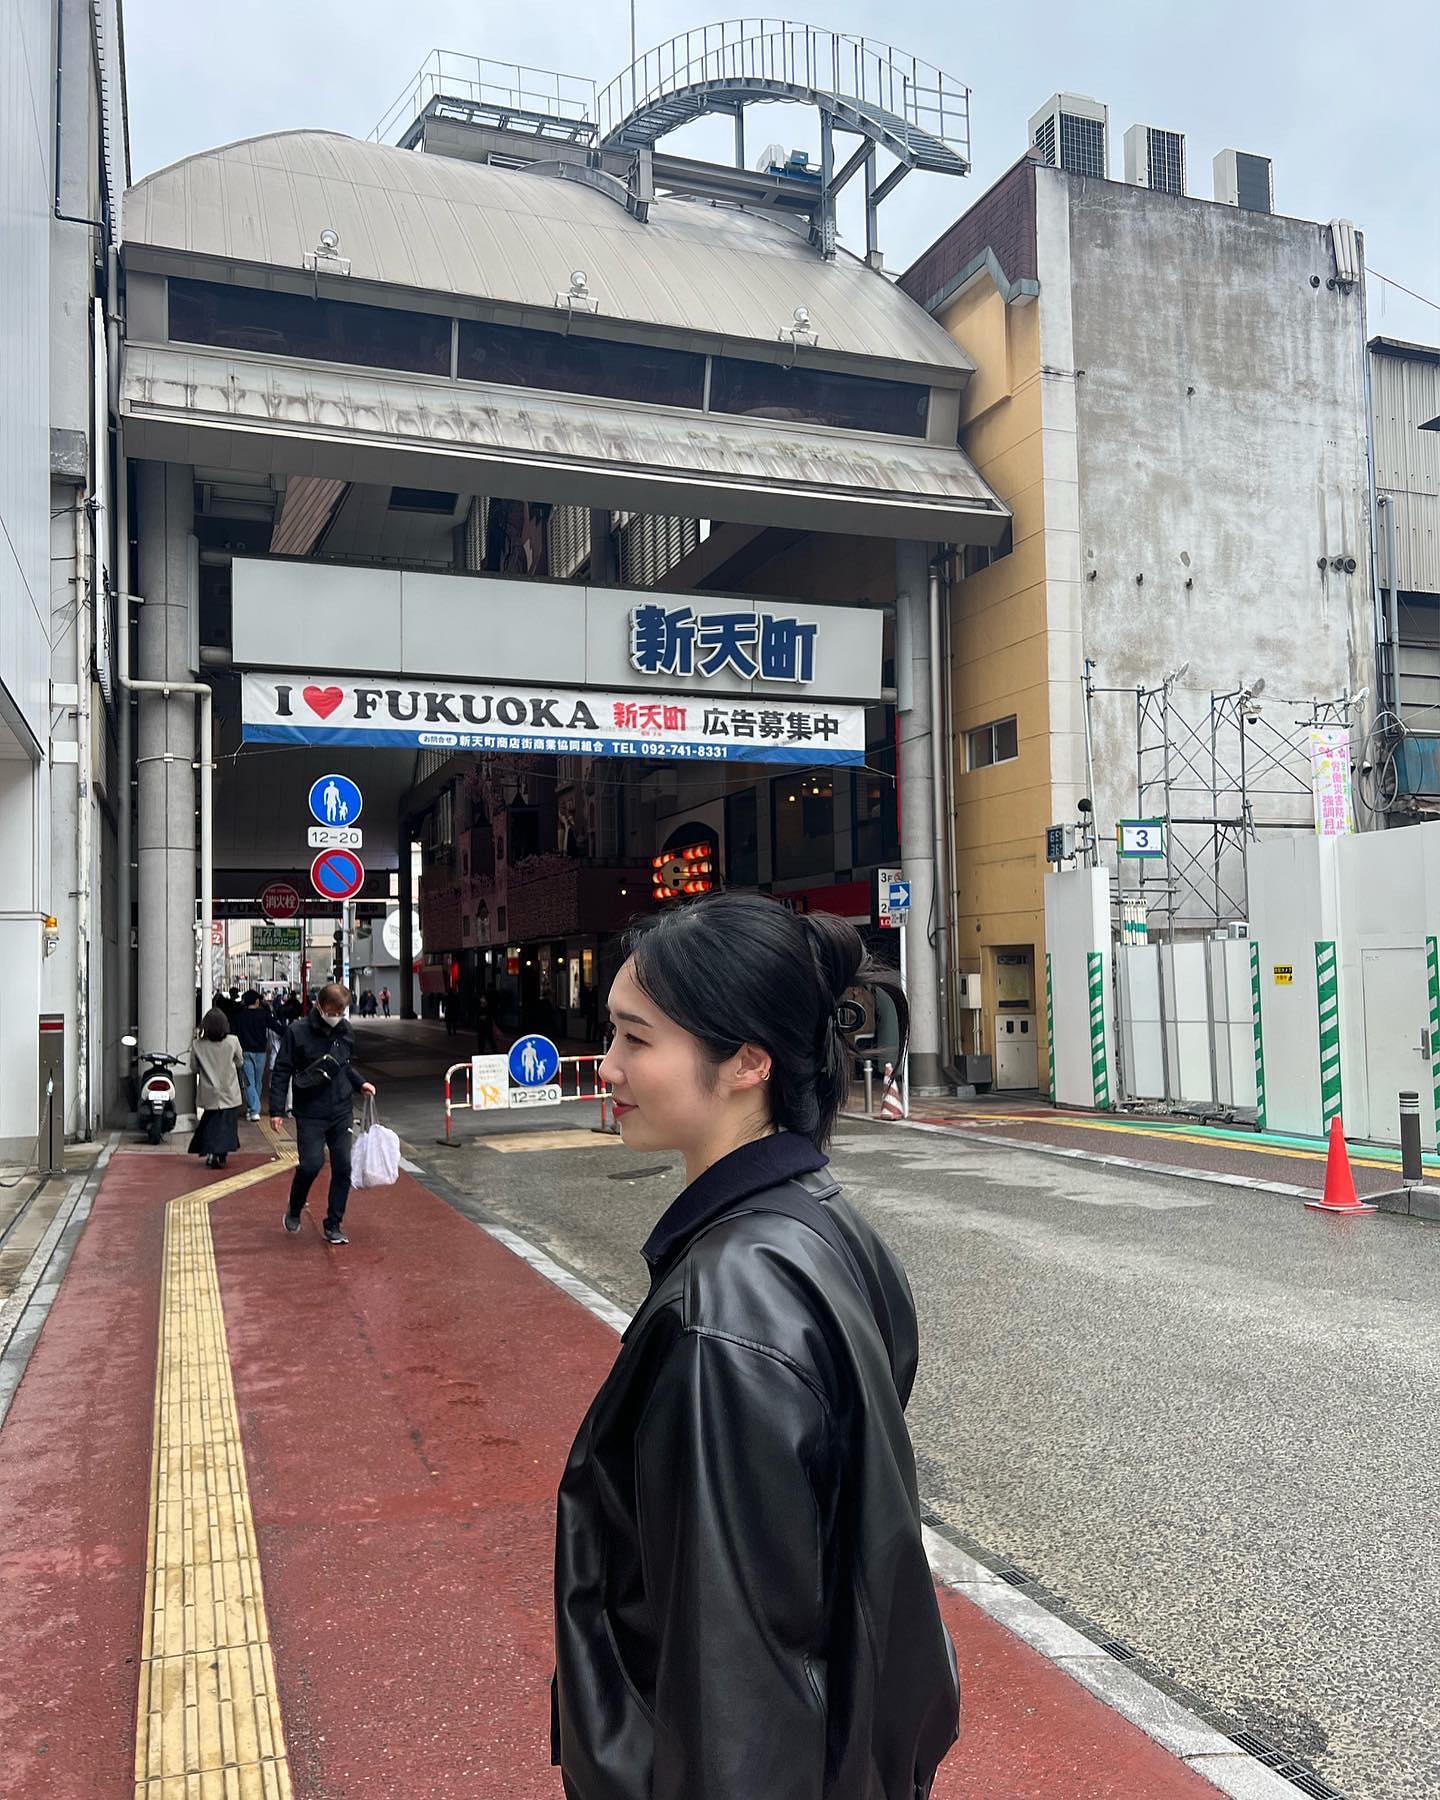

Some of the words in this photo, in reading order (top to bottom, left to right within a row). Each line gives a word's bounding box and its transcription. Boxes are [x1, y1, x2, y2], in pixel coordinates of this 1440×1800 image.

[633, 603, 819, 682] 新天町
[274, 685, 293, 717] I
[353, 688, 600, 730] FUKUOKA
[613, 702, 687, 731] 新天町
[702, 708, 839, 741] 広告募集中
[459, 734, 604, 753] 新天町商店街商業協同組合
[612, 742, 637, 754] TEL
[641, 743, 728, 758] 092-741-8331
[312, 831, 359, 844] 12-20
[1136, 829, 1149, 848] 3
[880, 872, 893, 883] 3F
[265, 894, 296, 909] 消火栓
[511, 1089, 557, 1104] 12-20
